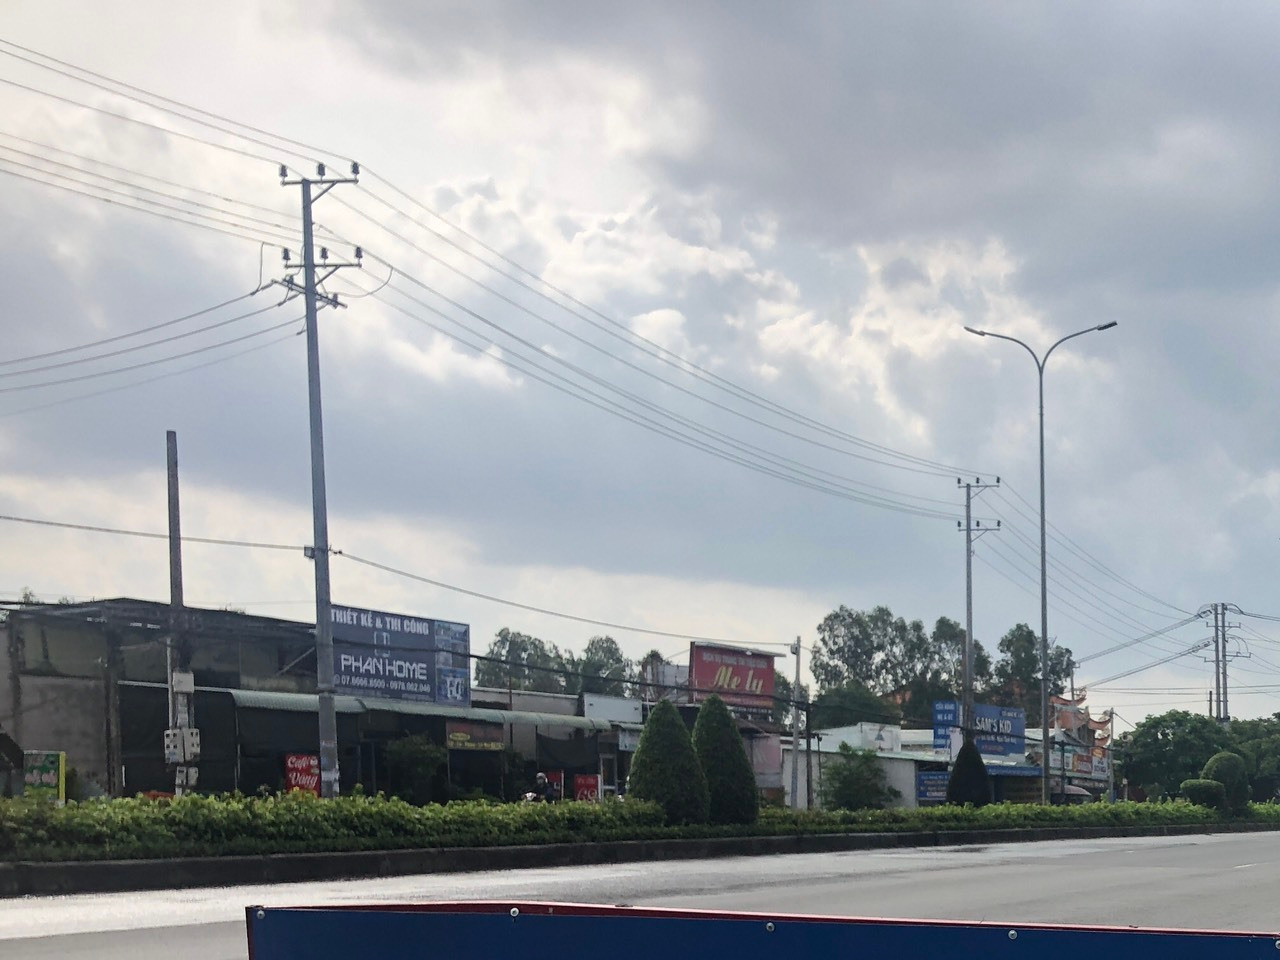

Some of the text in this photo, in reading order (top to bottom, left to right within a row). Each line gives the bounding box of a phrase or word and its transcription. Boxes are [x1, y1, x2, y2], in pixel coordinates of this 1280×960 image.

[340, 653, 428, 680] PHAN HOME
[999, 719, 1012, 734] KID
